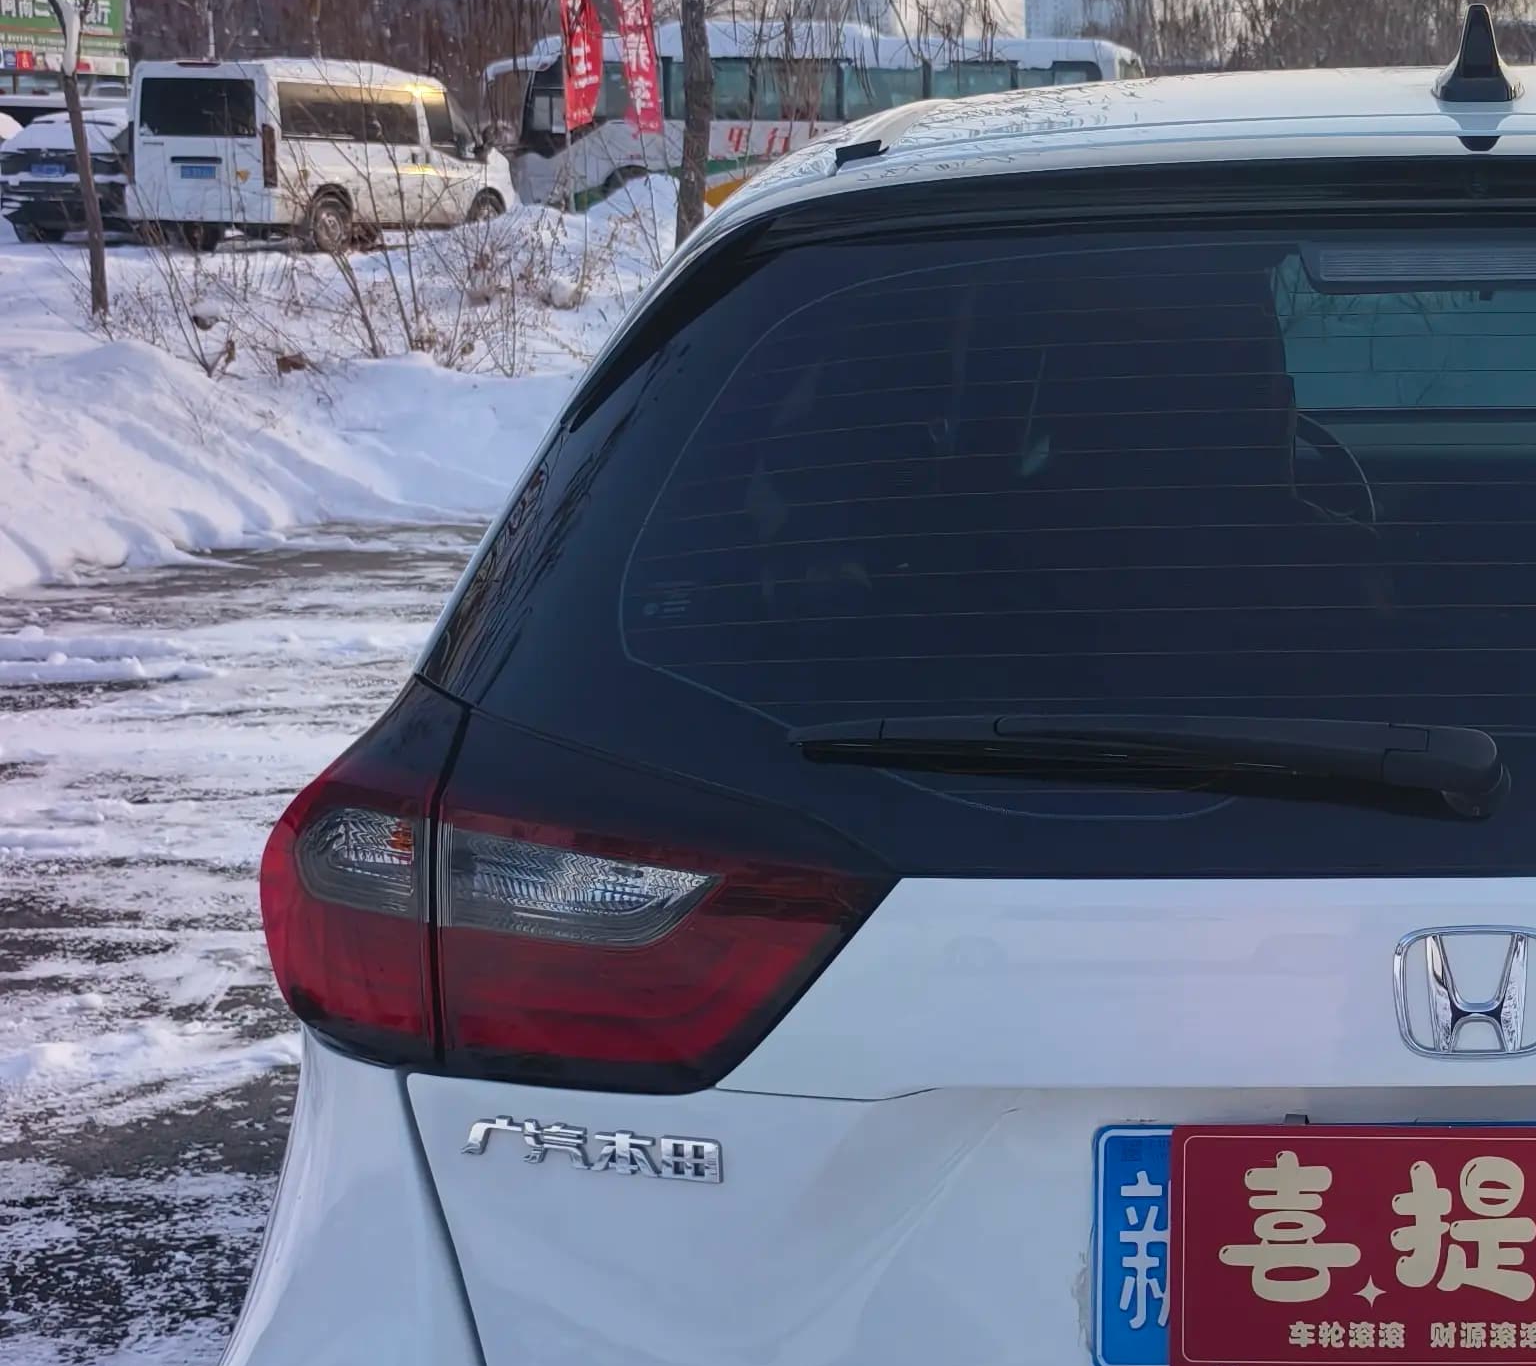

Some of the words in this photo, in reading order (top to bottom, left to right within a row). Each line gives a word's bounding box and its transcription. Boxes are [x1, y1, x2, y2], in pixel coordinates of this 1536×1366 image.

[460, 1114, 724, 1185] 广汽本田
[1288, 1321, 1405, 1348] 车轮滚滚
